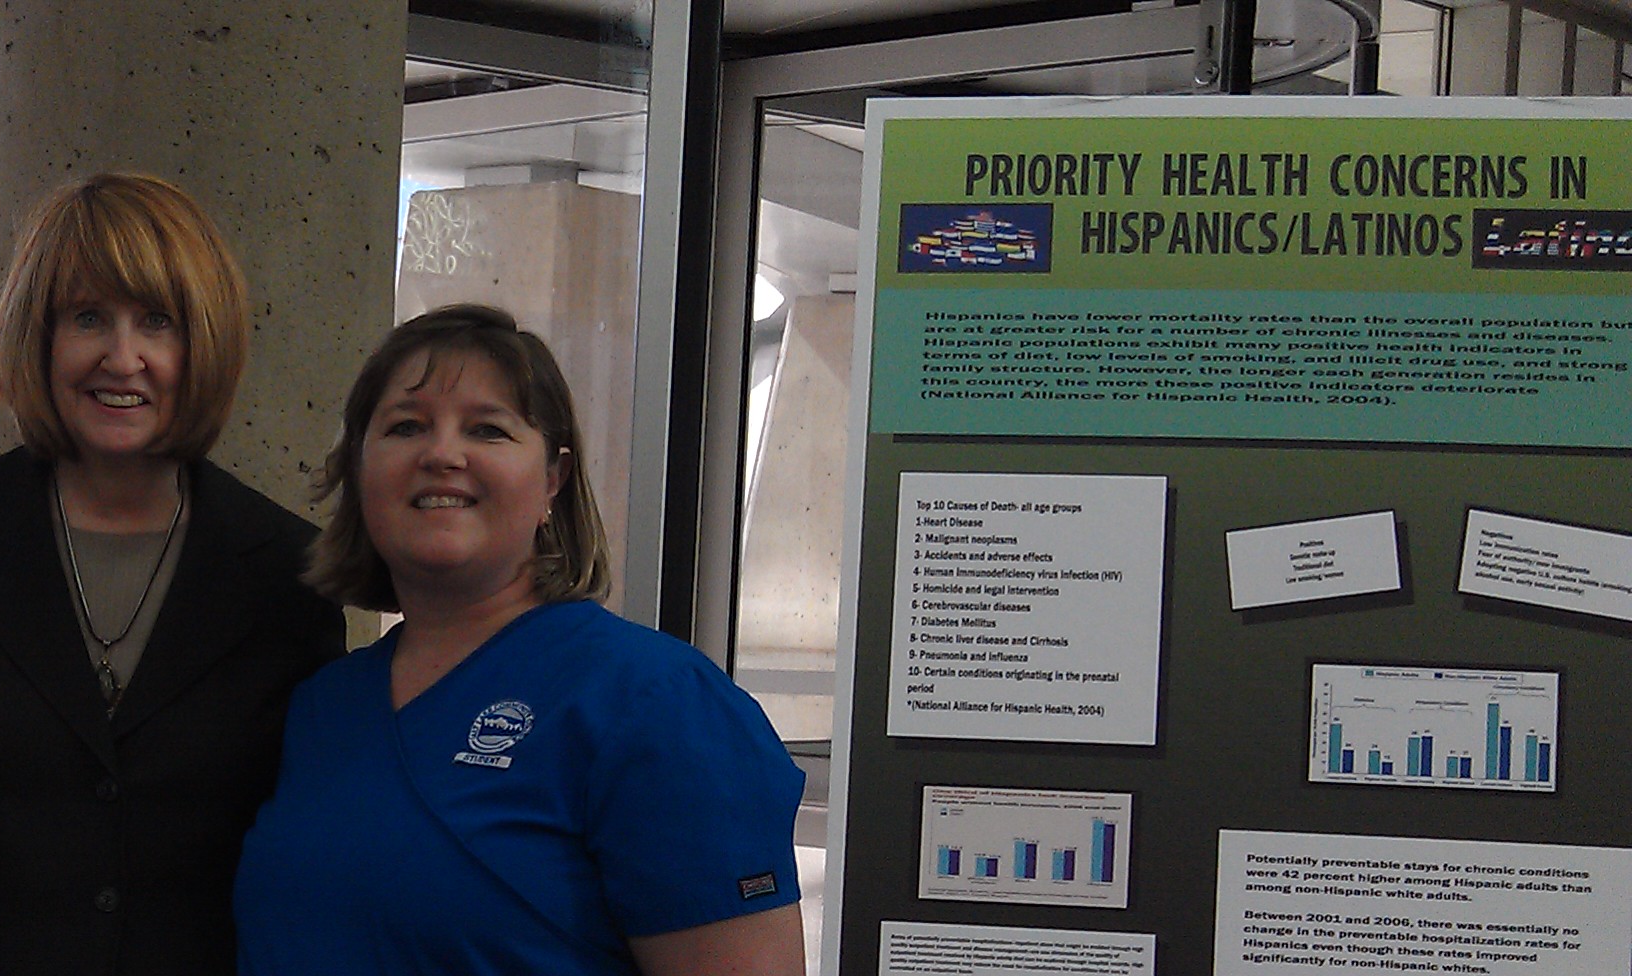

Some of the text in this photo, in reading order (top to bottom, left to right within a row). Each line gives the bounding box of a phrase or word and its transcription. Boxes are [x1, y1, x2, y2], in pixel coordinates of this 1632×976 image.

[965, 152, 1589, 199] PRIORITY HEALTH CONCERNS IN
[1080, 210, 1463, 257] HISPANICS/LATINOS
[916, 500, 931, 512] Top
[933, 500, 945, 510] 10
[946, 500, 978, 511] Causes
[979, 500, 989, 511] of
[1020, 501, 1032, 512] all
[1034, 503, 1050, 514] age
[1051, 503, 1082, 514] groups
[949, 516, 983, 528] Disease
[925, 533, 969, 546] Malignant
[971, 534, 1018, 546] neoplasms
[921, 616, 959, 627] Diabetes
[960, 617, 997, 628] Mellitus
[1246, 854, 1590, 879] Potentially preventable stays for chronic conditions
